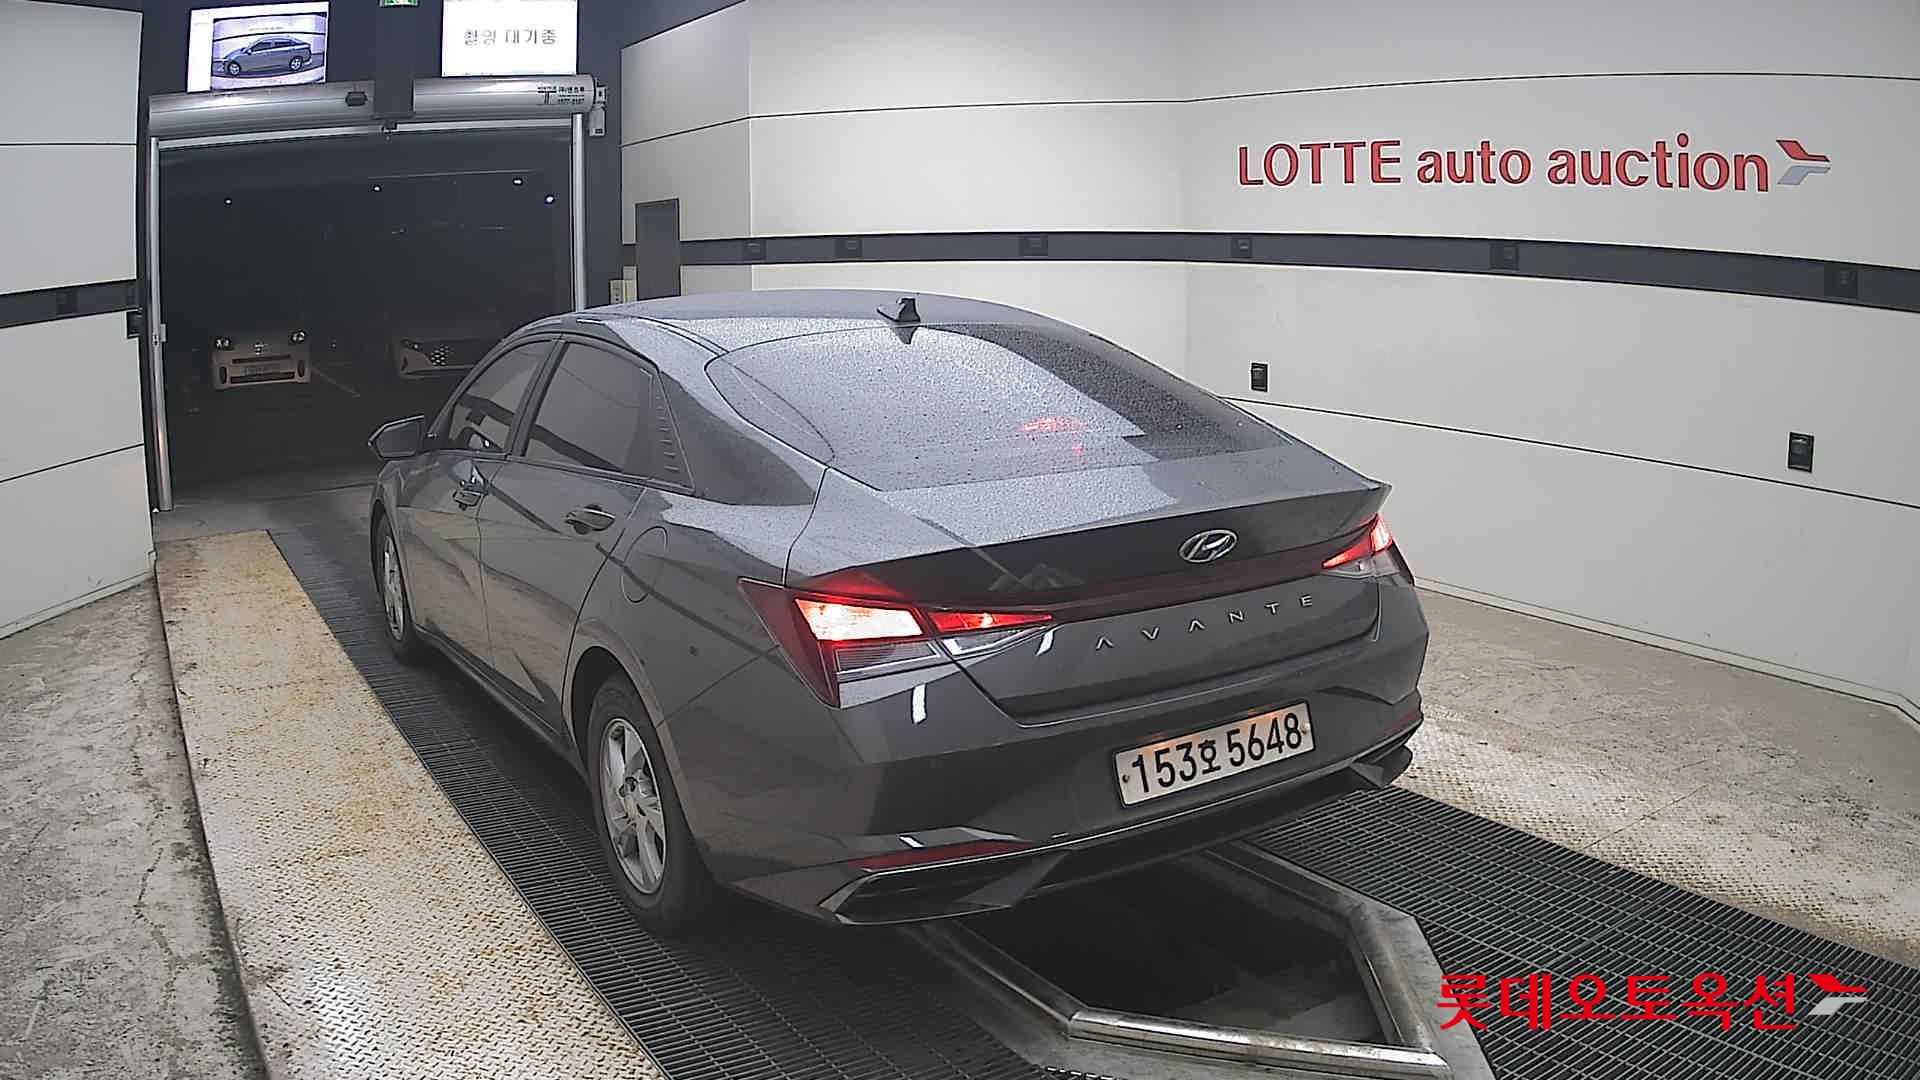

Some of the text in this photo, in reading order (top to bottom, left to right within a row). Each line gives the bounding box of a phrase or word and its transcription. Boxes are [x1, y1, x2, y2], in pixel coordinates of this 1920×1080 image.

[504, 28, 557, 46] 대기중
[1239, 133, 1770, 191] LOTTE auto auction
[1096, 595, 1313, 650] AVANTE
[1131, 711, 1303, 793] 153호 5648
